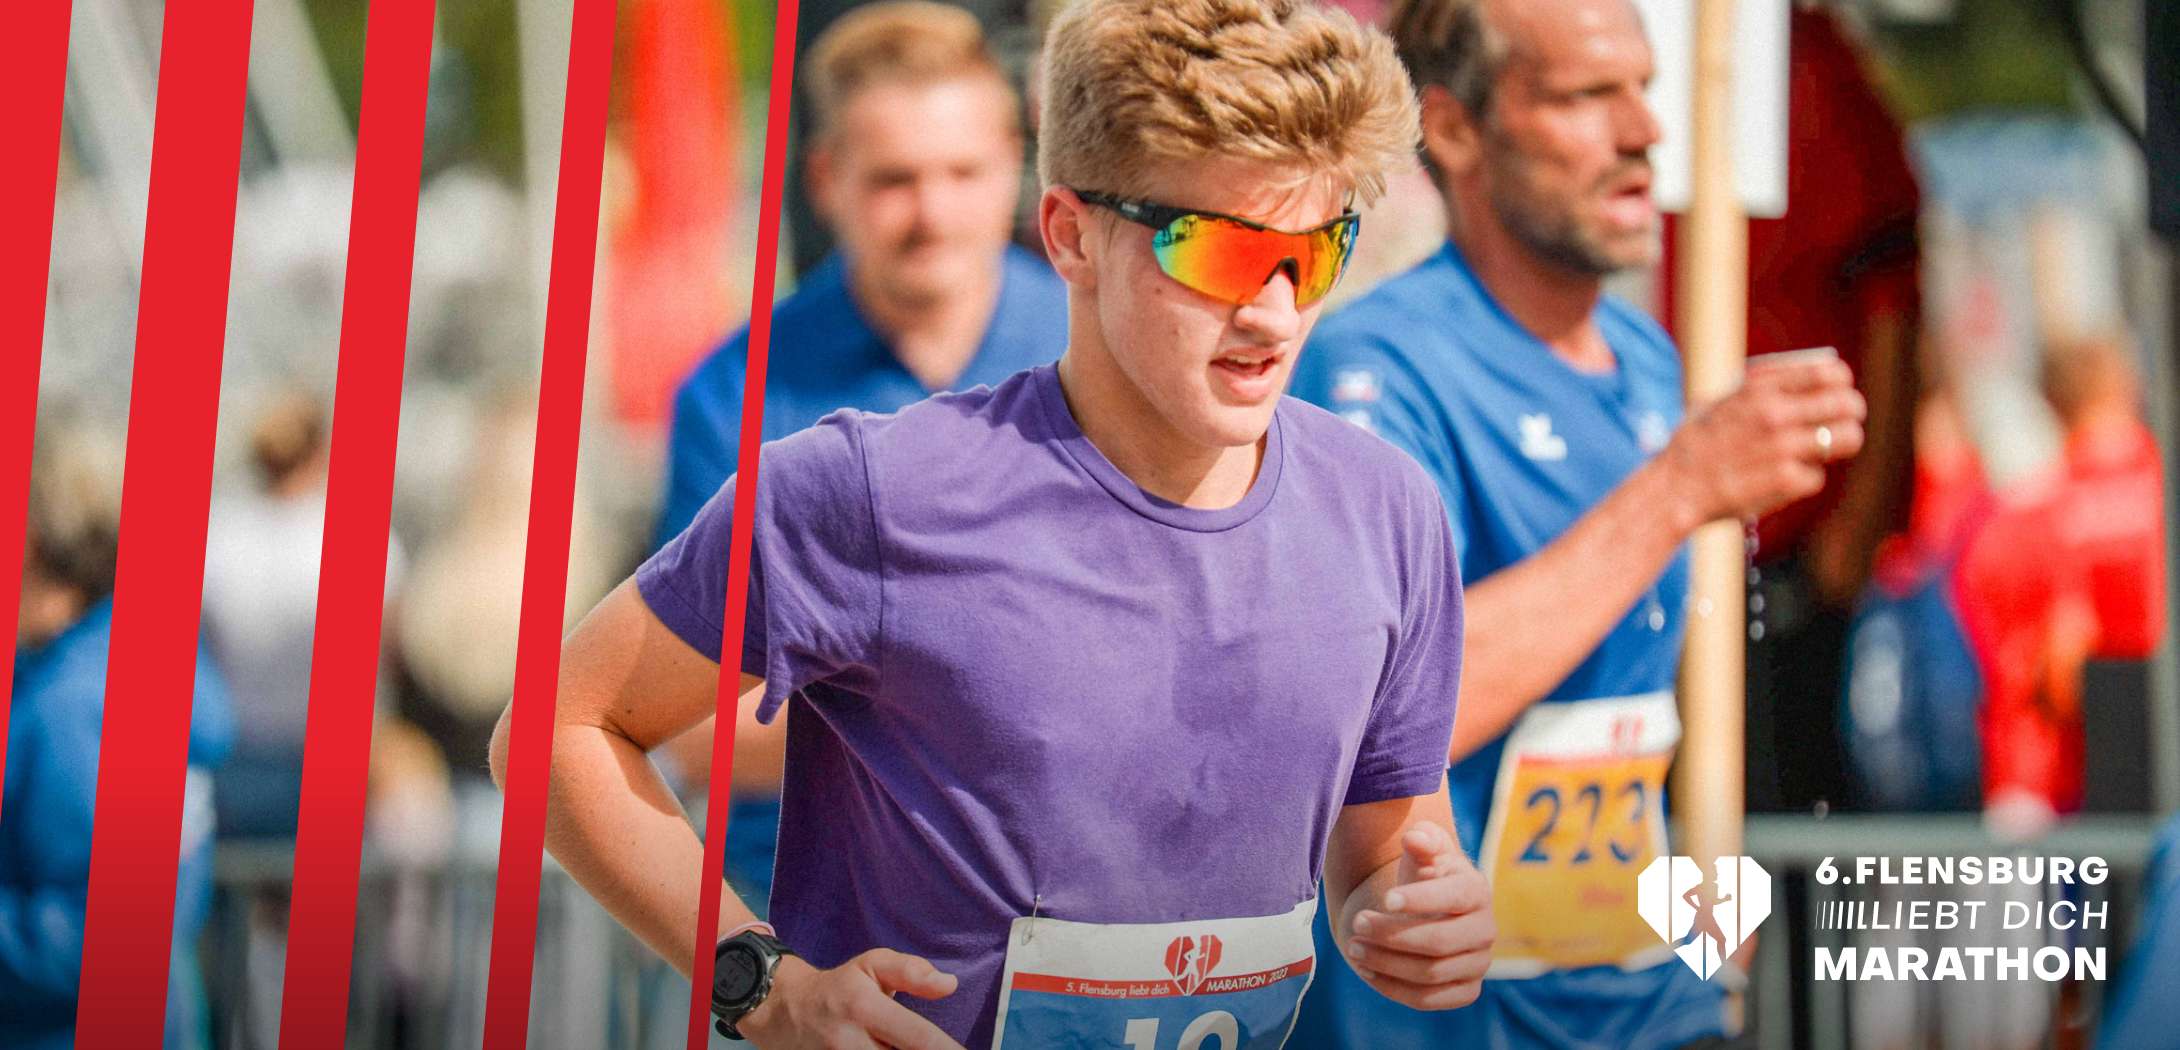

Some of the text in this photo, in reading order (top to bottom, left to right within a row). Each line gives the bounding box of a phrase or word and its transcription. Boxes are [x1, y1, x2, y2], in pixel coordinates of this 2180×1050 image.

[1080, 983, 1127, 999] Flensburg
[1129, 984, 1150, 995] liebt
[1151, 984, 1170, 995] dich
[1206, 974, 1266, 992] MARATHON
